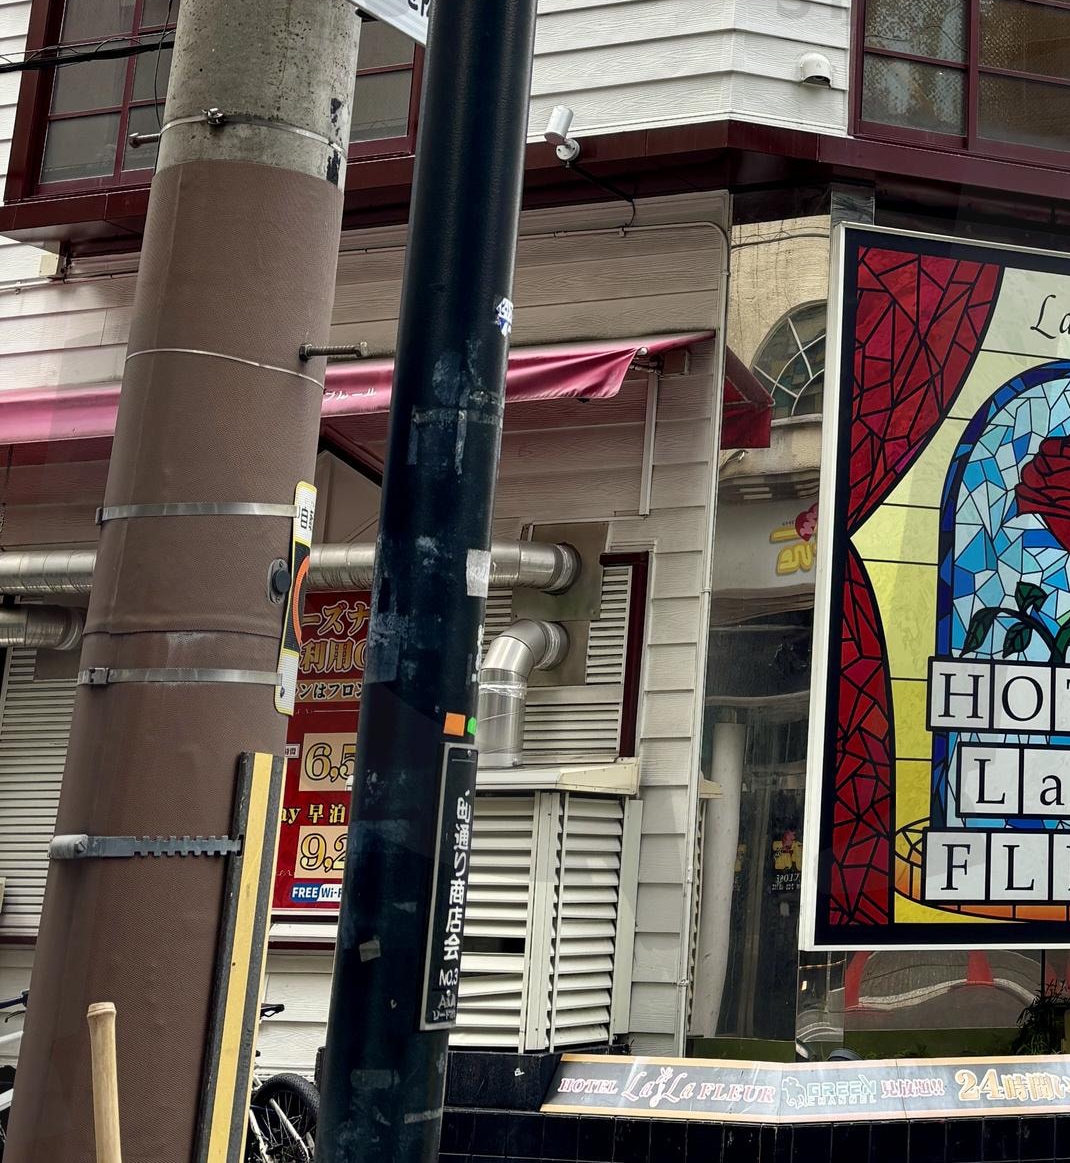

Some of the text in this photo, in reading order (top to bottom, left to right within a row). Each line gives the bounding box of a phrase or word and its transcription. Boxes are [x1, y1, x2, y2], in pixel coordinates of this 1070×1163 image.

[292, 887, 319, 898] FREE
[557, 1077, 619, 1095] HOTEL
[697, 1082, 776, 1104] FLEUR
